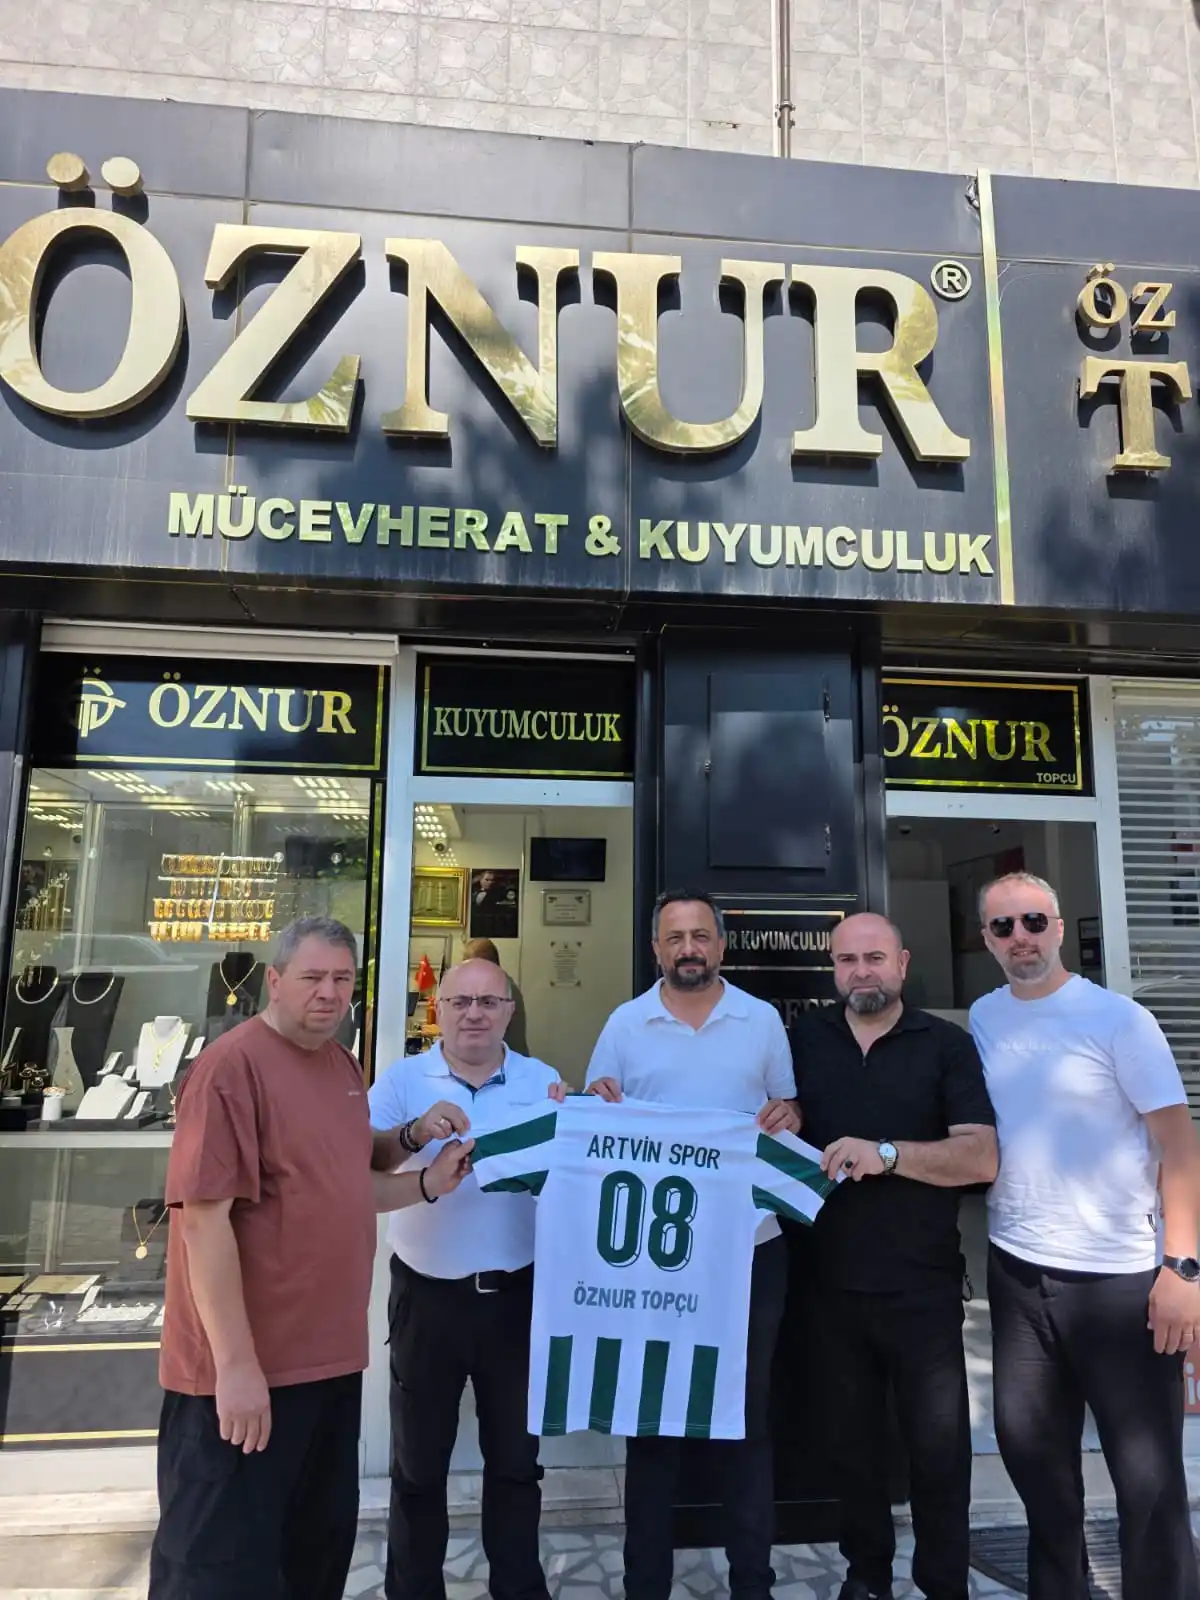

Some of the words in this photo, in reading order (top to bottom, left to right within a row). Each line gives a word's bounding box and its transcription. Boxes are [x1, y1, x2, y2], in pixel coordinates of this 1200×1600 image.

[0, 152, 970, 462] ÖZNUR
[1076, 263, 1176, 330] ÖZ
[1080, 356, 1192, 470] T
[168, 486, 569, 555] MÜCEVHERAT
[585, 515, 621, 556] &
[639, 519, 994, 575] KUYUMCULUK
[149, 671, 356, 734] ÖZNUR
[433, 706, 622, 742] KUYUMCULUK
[882, 704, 1057, 762] ÖZNUR
[1036, 772, 1076, 785] TOPÇU
[587, 1134, 662, 1163] ARTVİN
[668, 1143, 720, 1170] SPOR
[596, 1170, 698, 1273] 08
[574, 1280, 637, 1309] ÖZNUR
[641, 1290, 699, 1318] TOPÇU
